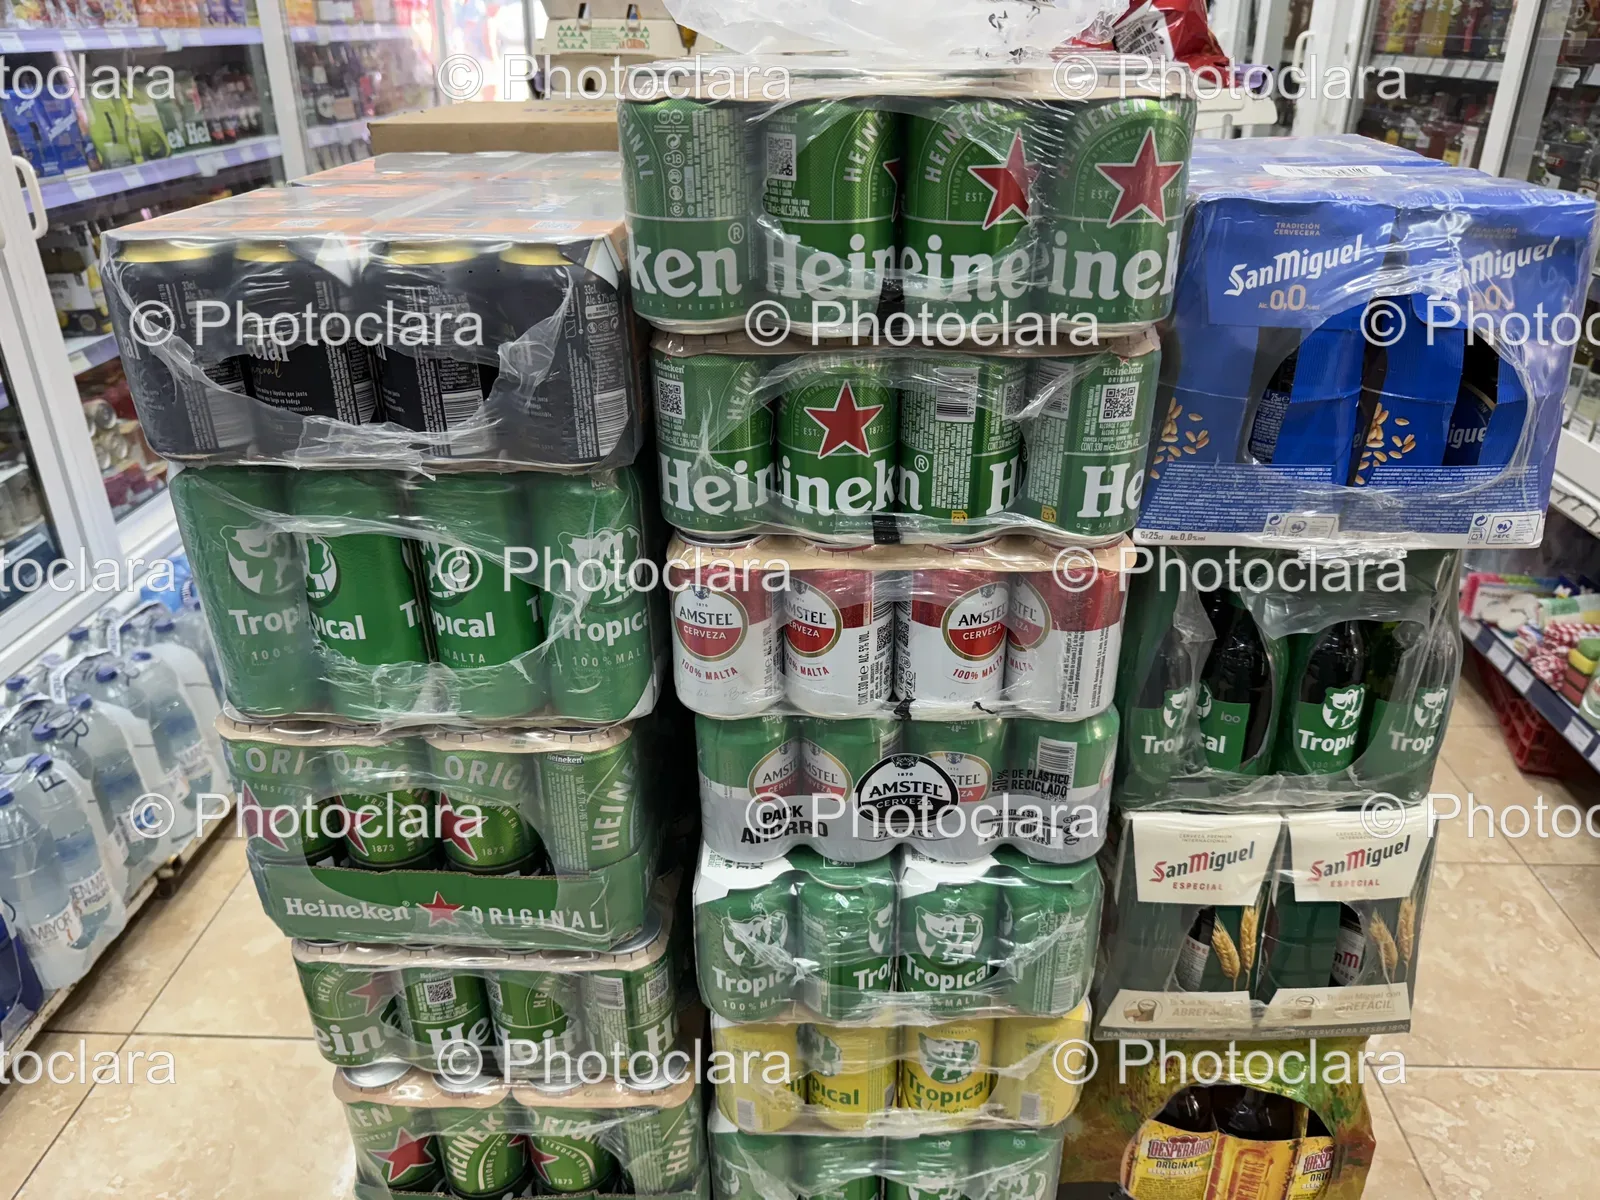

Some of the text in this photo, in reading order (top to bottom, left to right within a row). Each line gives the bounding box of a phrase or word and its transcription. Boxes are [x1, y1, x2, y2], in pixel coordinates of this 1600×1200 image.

[1275, 220, 1321, 229] TRADICIÓN
[1273, 228, 1321, 237] CERVECERA
[679, 605, 732, 627] AMSTEL
[683, 625, 727, 640] CERVEZA
[681, 658, 738, 681] 100% MALTA
[800, 665, 830, 677] MALTA
[952, 667, 979, 680] 100%
[1012, 769, 1024, 779] DE
[869, 780, 943, 798] AMSTEL
[1011, 779, 1068, 798] RECICLADO
[1172, 882, 1223, 891] ESPECIAL
[1330, 879, 1381, 888] ESPECIAL
[283, 897, 605, 929] Heineken ORIGINAL
[906, 1067, 988, 1106] Tropical
[1156, 1160, 1198, 1169] ORIGINAL
